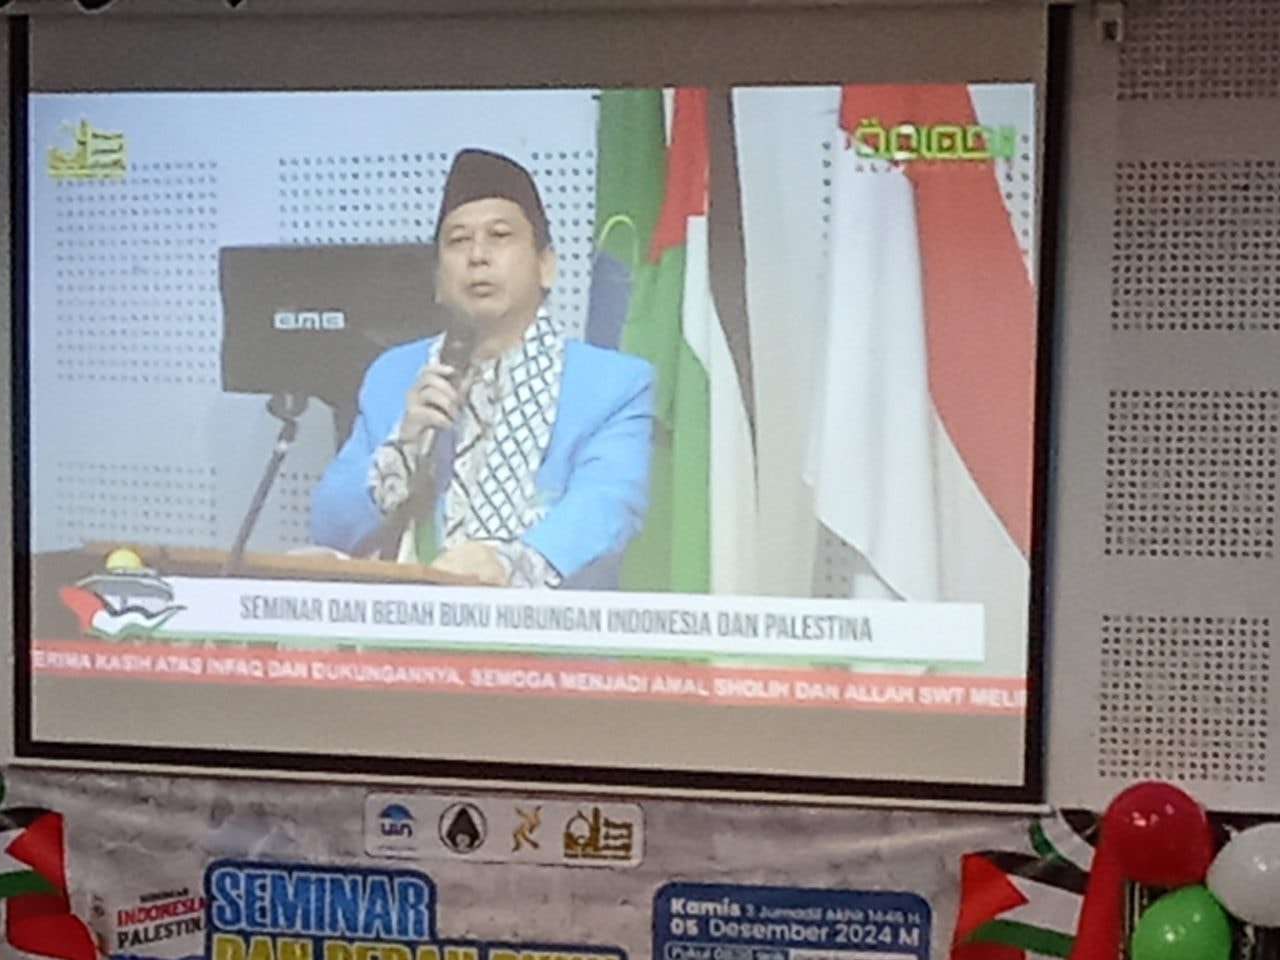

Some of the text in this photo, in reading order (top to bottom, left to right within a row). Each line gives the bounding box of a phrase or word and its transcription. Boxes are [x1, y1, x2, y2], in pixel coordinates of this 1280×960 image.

[240, 594, 873, 642] SEMINAR DAN BEDAH BUKU HUBUNGAN INDONESIA DAN PALESTINA
[32, 650, 91, 669] ERIMA
[95, 653, 153, 672] KASIH
[155, 656, 202, 675] ATAS
[207, 657, 263, 679] INFAQ
[268, 660, 307, 679] DAN
[653, 677, 710, 697] AMAL
[795, 682, 839, 701] DAN
[845, 684, 916, 703] ALLAH
[921, 687, 966, 705] SWT
[211, 866, 430, 941] SEMINAR
[670, 897, 741, 918] Kamis
[117, 916, 202, 950] PALESTIN
[670, 917, 920, 947] 05 Desember 2024 M
